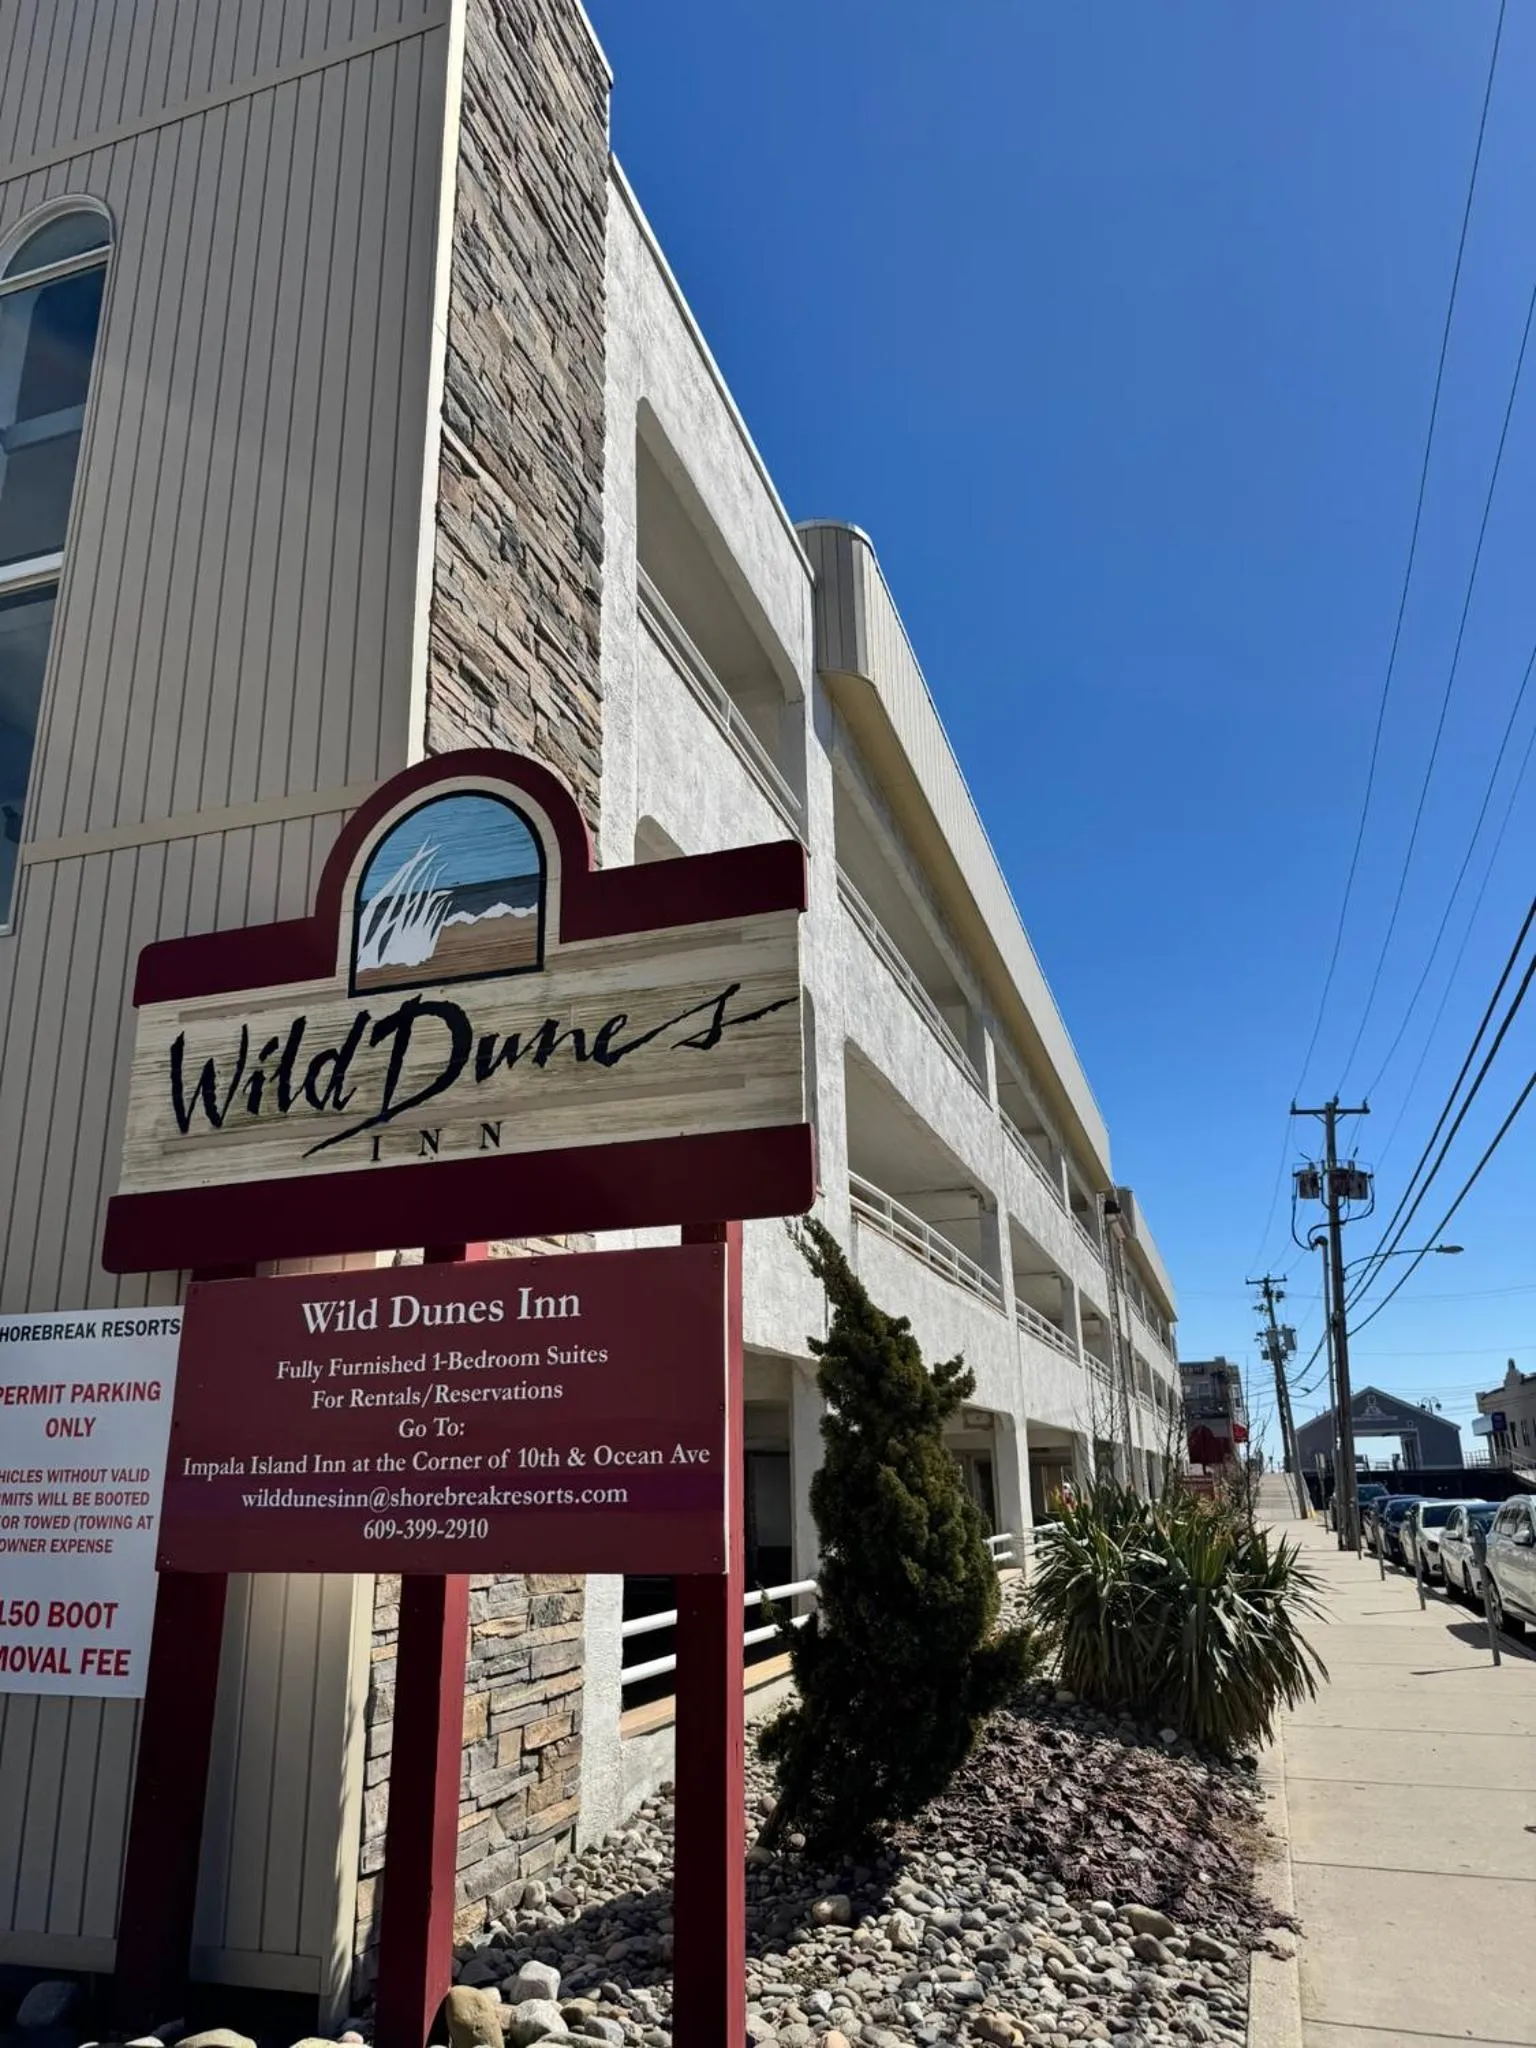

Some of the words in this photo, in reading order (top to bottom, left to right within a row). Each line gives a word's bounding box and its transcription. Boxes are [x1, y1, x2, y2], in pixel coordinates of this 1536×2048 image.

[170, 1010, 371, 1134] Wild
[303, 983, 799, 1157] Dunes
[371, 1121, 503, 1161] INN
[302, 1297, 378, 1334] Wild
[389, 1296, 504, 1329] Dunes
[517, 1287, 581, 1320] Inn
[101, 1319, 181, 1338] RESORTS
[276, 1360, 323, 1384] Fully
[328, 1353, 426, 1377] Furnished
[432, 1350, 540, 1371] 1-Bedroom
[547, 1344, 608, 1365] Suites
[0, 1384, 66, 1405] ERMIT
[71, 1381, 161, 1403] PARKING
[311, 1390, 345, 1409] For
[350, 1380, 563, 1409] Rentals/Reservations
[45, 1417, 96, 1438] ONLY
[398, 1418, 427, 1438] Go
[433, 1416, 465, 1437] To:
[183, 1457, 245, 1482] Impala
[250, 1455, 307, 1475] Island
[314, 1454, 346, 1474] Inn
[352, 1457, 370, 1472] at
[376, 1453, 406, 1472] the
[412, 1451, 482, 1472] Corner
[488, 1448, 511, 1469] of
[518, 1447, 560, 1468] 10th
[567, 1447, 586, 1467] &
[594, 1445, 663, 1466] Ocean
[670, 1443, 710, 1464] Ave
[47, 1469, 108, 1483] WITHOUT
[111, 1468, 150, 1482] VALID
[37, 1492, 68, 1506] WILL
[73, 1492, 91, 1506] BE
[94, 1492, 150, 1506] BOOTED
[242, 1485, 628, 1513] wilddunesinn@shorebreakresorts.com
[23, 1515, 70, 1529] TOWED
[74, 1515, 132, 1532] (TOWING
[137, 1515, 154, 1529] AT
[363, 1518, 489, 1540] 609-399-2910
[51, 1539, 114, 1553] EXPENSE
[48, 1602, 118, 1629] BOOT
[80, 1649, 131, 1676] FEE
